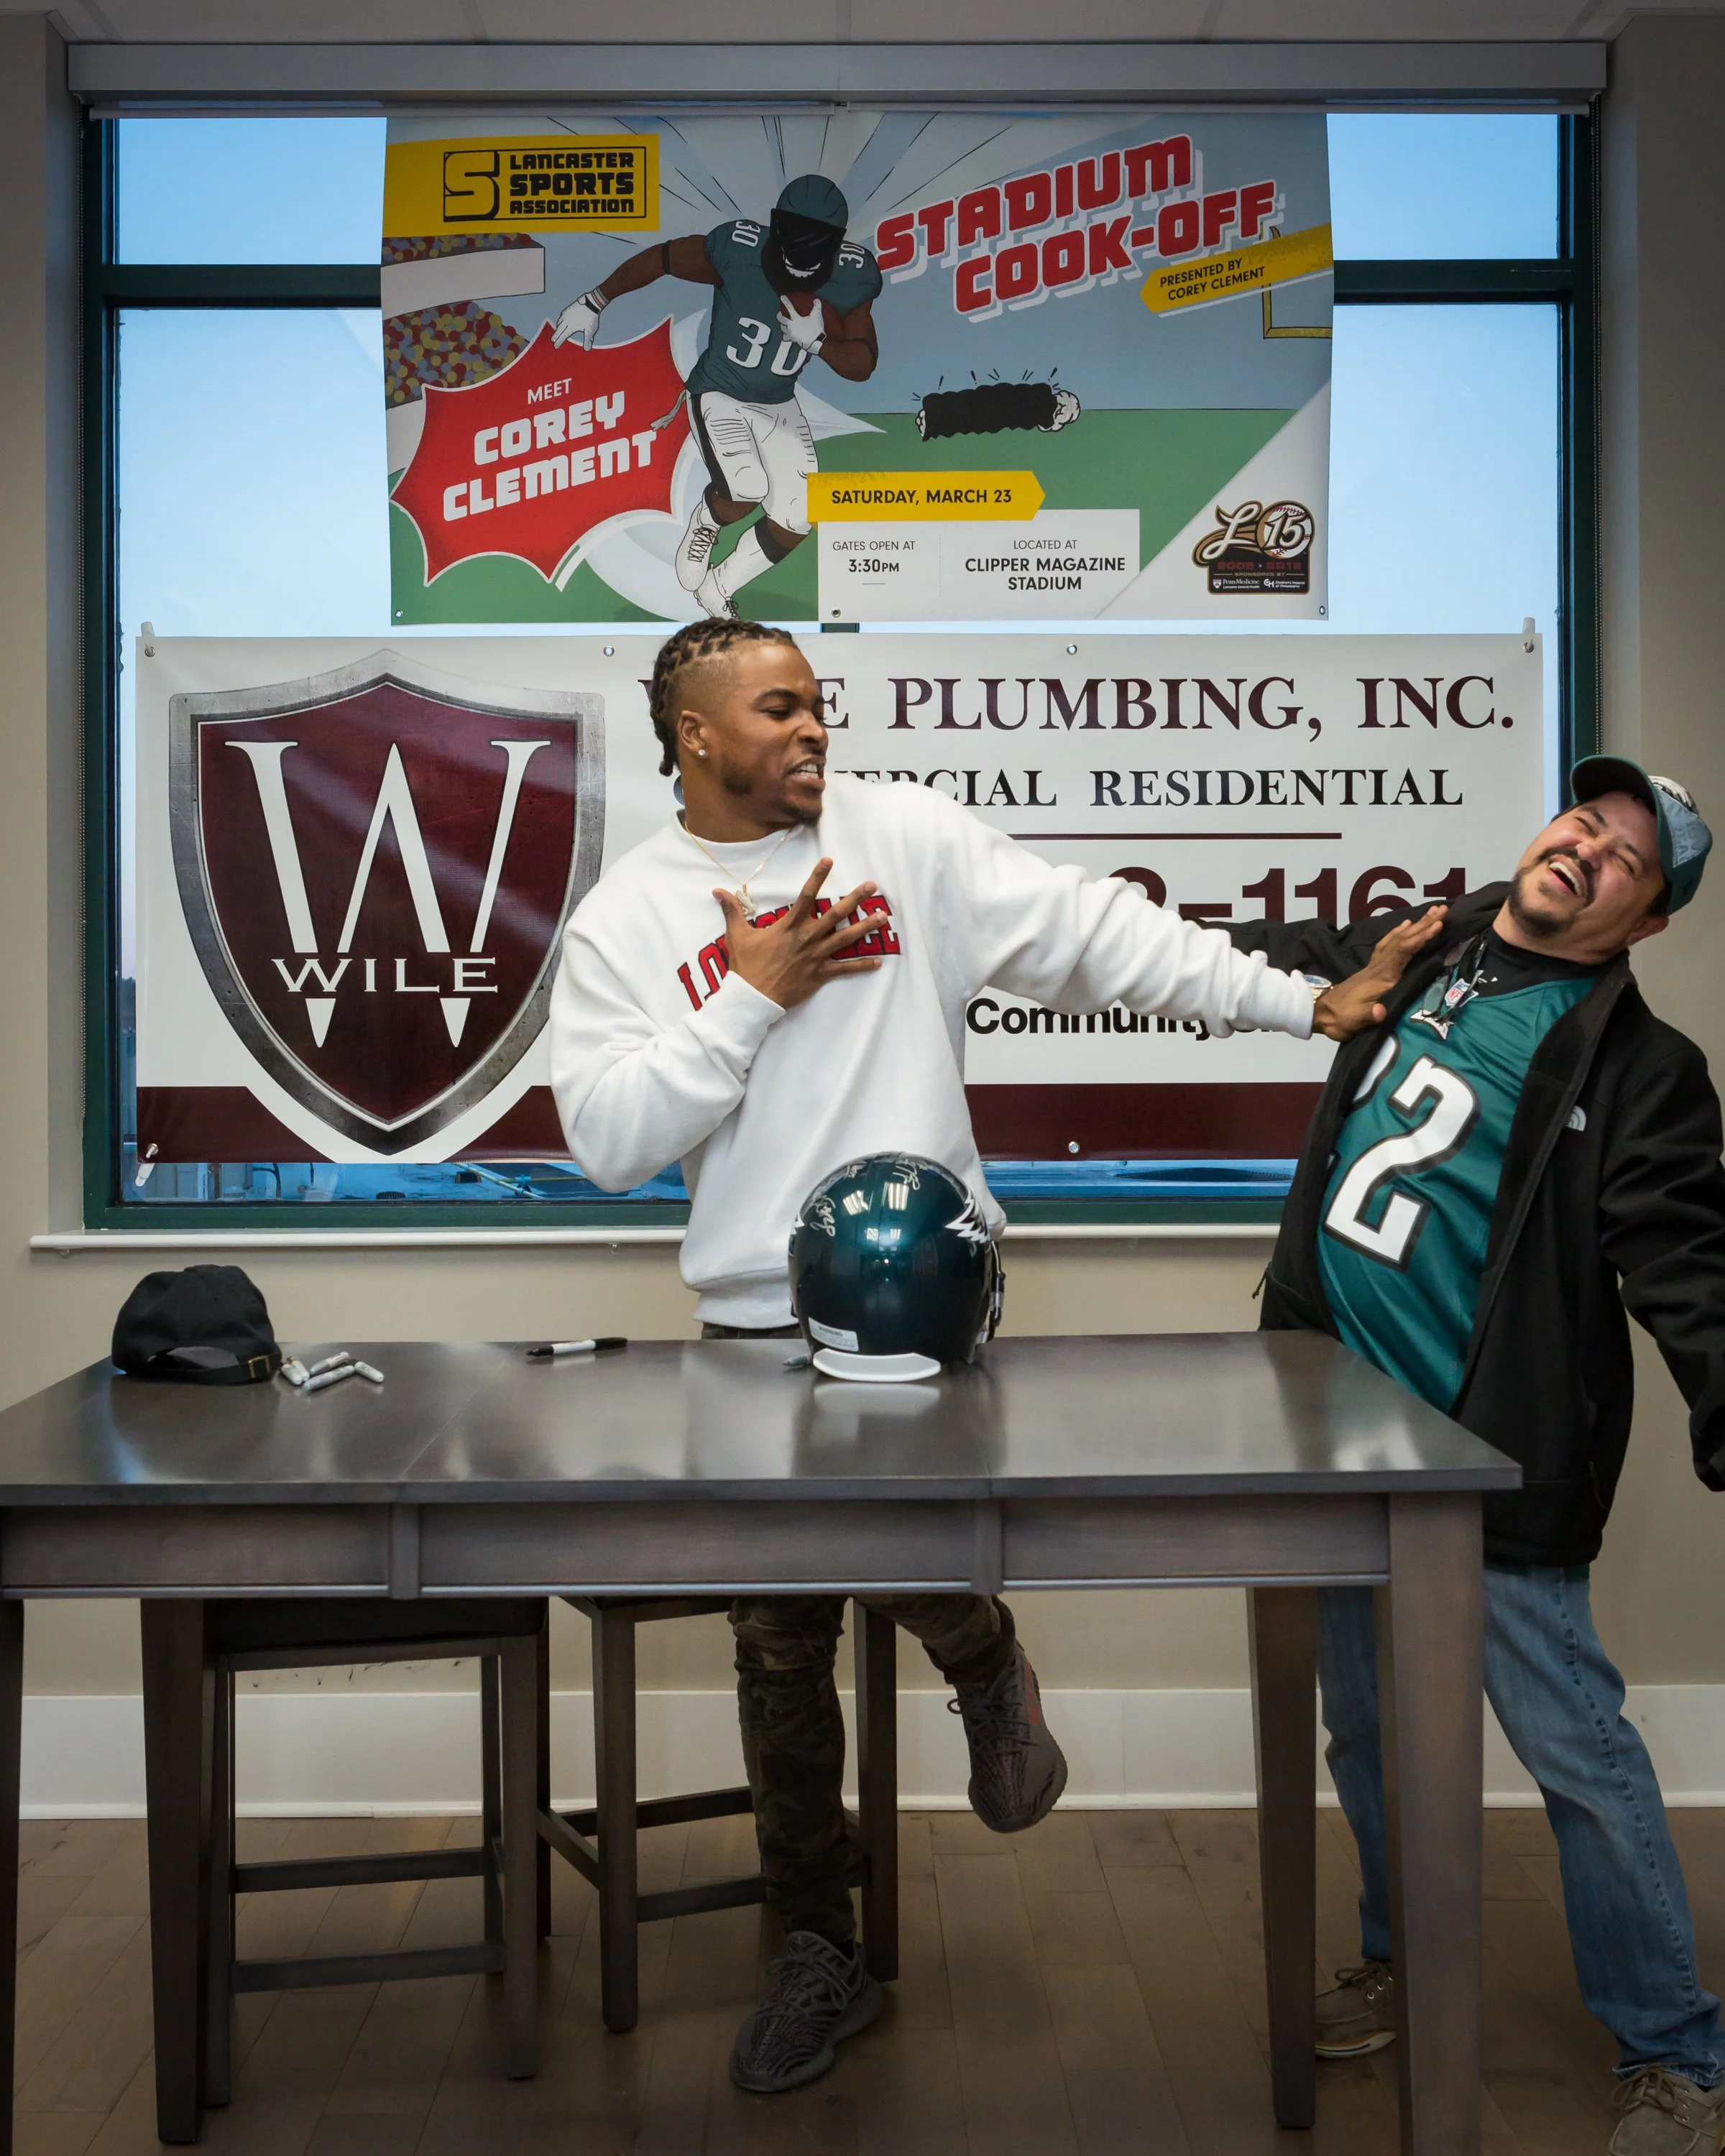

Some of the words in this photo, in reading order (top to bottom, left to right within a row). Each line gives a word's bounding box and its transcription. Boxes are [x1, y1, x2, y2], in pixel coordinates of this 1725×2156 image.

[510, 152, 634, 170] LANCASTER
[510, 172, 634, 196] SPORTS
[510, 198, 634, 214] ASSOCIATION
[875, 134, 1192, 269] STADIUM
[731, 220, 761, 248] 30
[954, 180, 1276, 314] COOK-OFF
[838, 242, 865, 270] 30
[1159, 263, 1223, 288] PRESENTED
[1227, 257, 1243, 272] BY
[1167, 282, 1208, 301] COREY
[1210, 266, 1266, 290] CLEMENT
[726, 316, 808, 377] 30
[527, 377, 572, 405] MEET
[474, 390, 625, 466] COREY
[443, 429, 657, 522] CLEMENT
[831, 489, 920, 505] SATURDAY,
[926, 489, 988, 504] MARCH
[993, 489, 1012, 503] 23
[1265, 510, 1307, 549] 15
[832, 540, 865, 551] GATES
[868, 540, 899, 551] OPEN
[903, 540, 916, 550] AT
[1013, 540, 1061, 550] LOCATED
[1064, 539, 1077, 550] AT
[965, 558, 1030, 573] CLIPPER
[1036, 557, 1126, 572] MAGAZINE
[1008, 576, 1082, 591] STADIUM
[887, 676, 1322, 742] PLUMBING,
[1356, 676, 1514, 729] INC.
[1089, 768, 1463, 806] RESIDENTIAL
[271, 957, 499, 992] WILE
